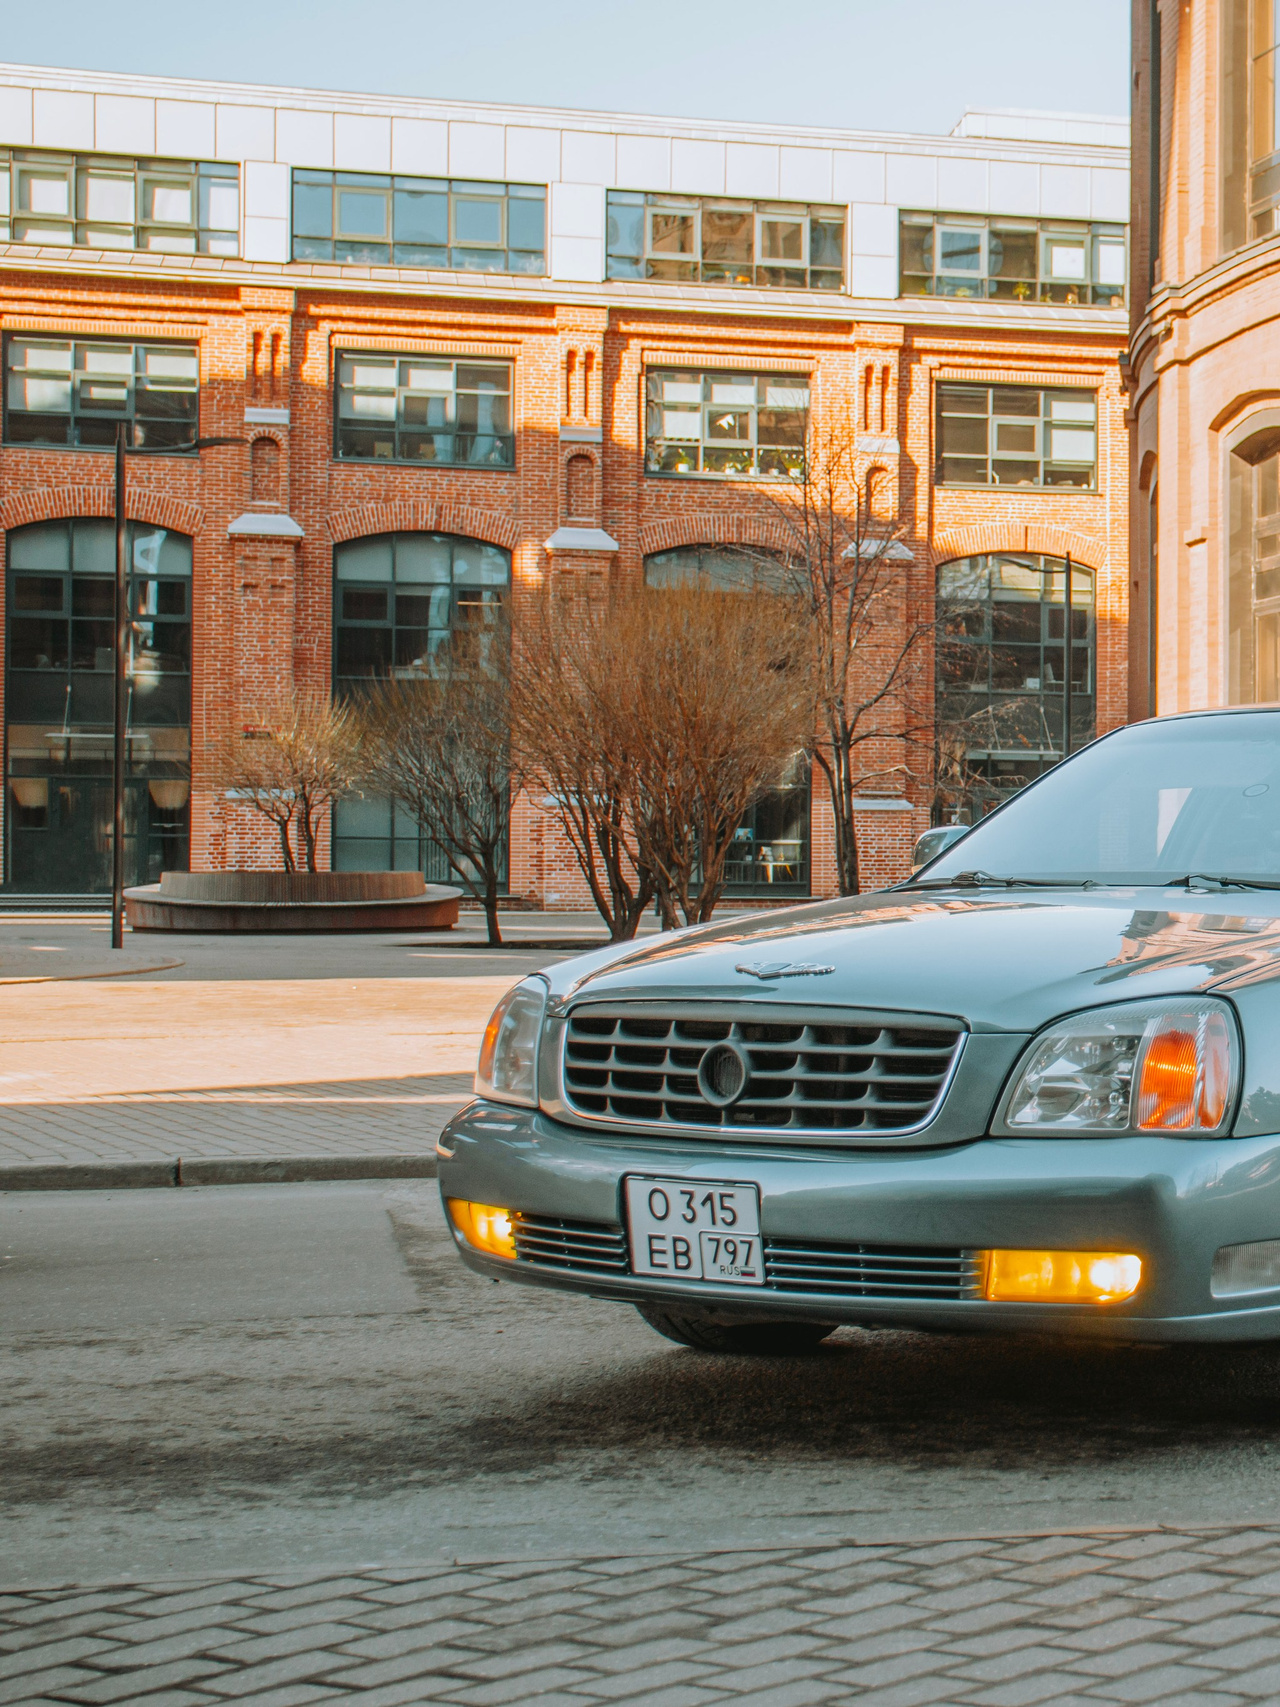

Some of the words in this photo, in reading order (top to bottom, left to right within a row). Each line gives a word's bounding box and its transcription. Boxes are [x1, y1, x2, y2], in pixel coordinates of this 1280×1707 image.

[680, 1189, 737, 1226] 315
[708, 1237, 752, 1265] 797
[720, 1266, 740, 1275] RUS
